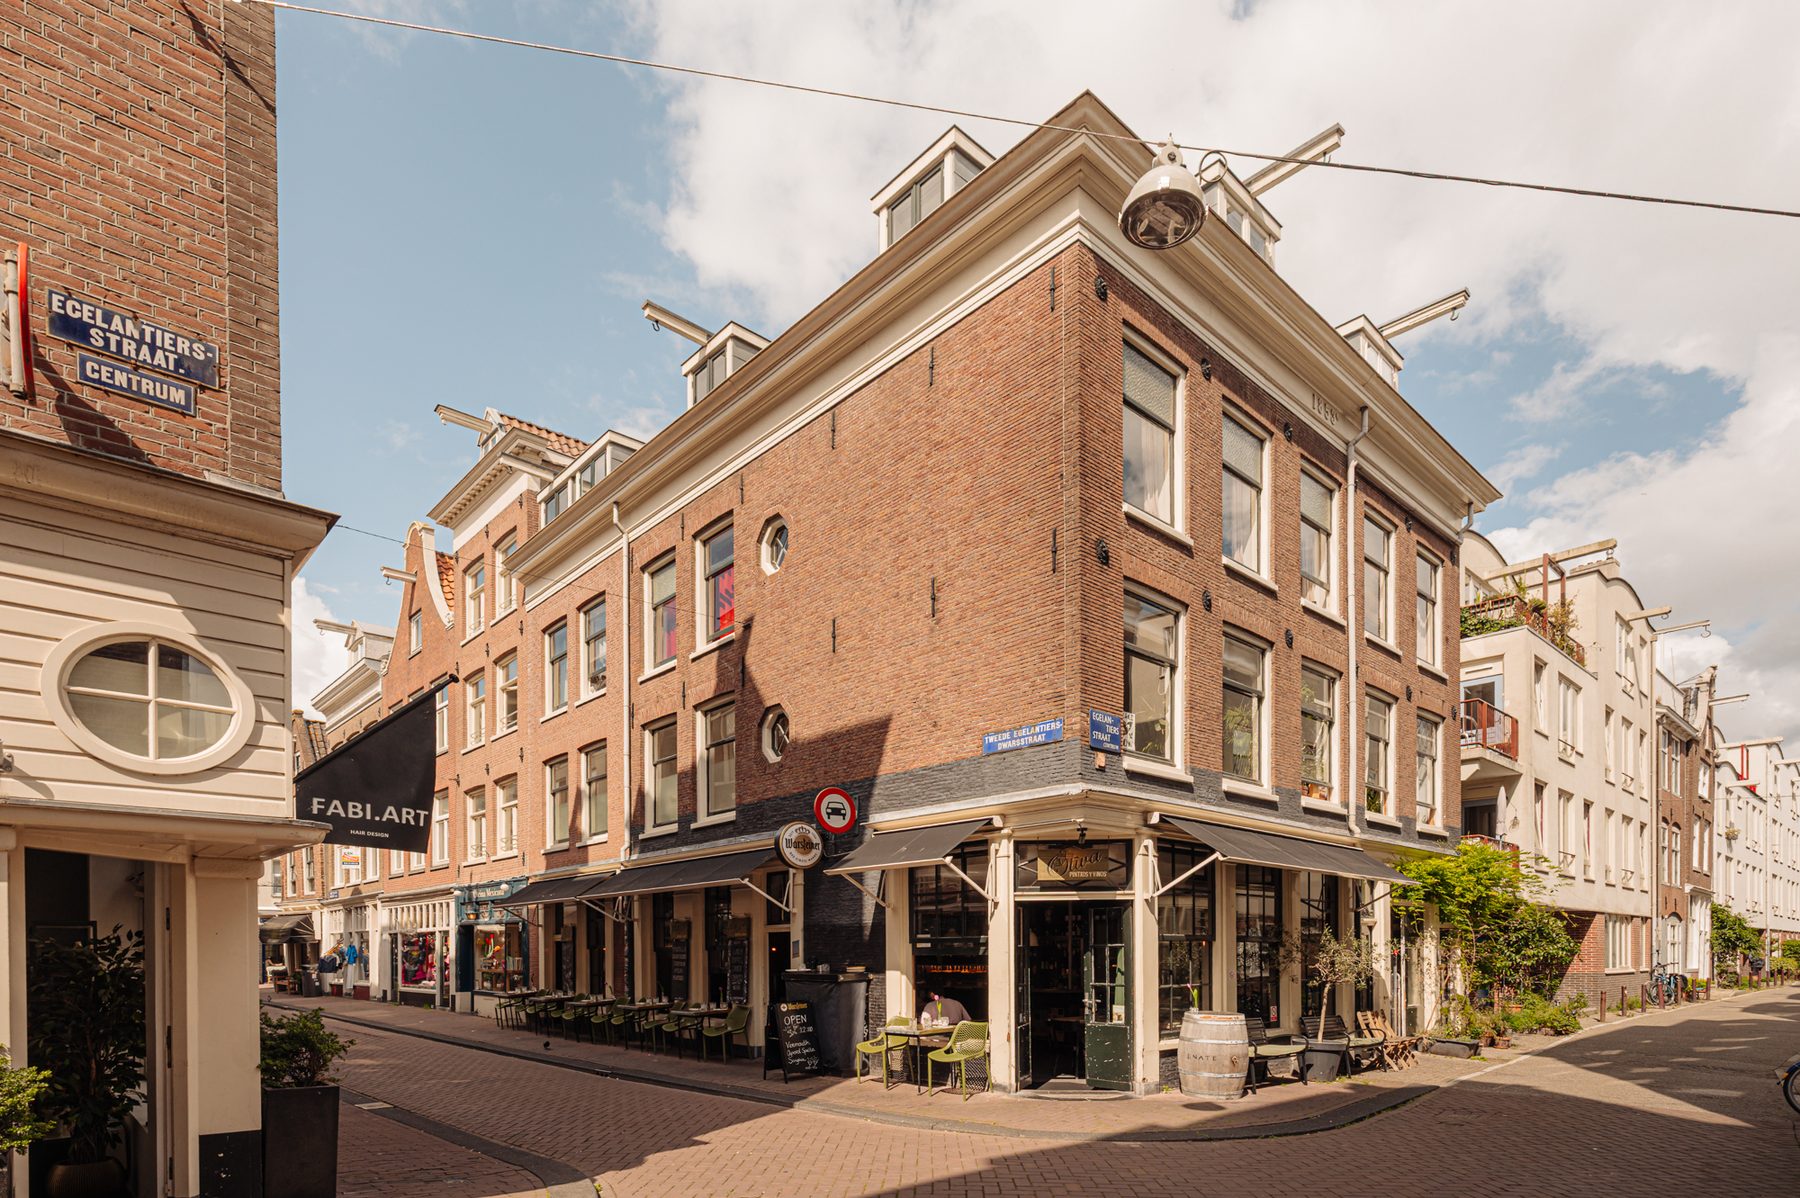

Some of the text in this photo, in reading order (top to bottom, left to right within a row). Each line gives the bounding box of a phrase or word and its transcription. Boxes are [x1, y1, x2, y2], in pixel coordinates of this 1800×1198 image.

[85, 360, 186, 406] CENTRUM
[1092, 730, 1111, 742] STRAAT
[1105, 724, 1120, 736] TIERS
[984, 731, 1011, 745] TWEEDE
[997, 733, 1046, 751] DWARSSTRAAT
[310, 797, 429, 827] FABI.ART
[785, 838, 820, 851] Warsteiner
[784, 1014, 807, 1026] OPEN
